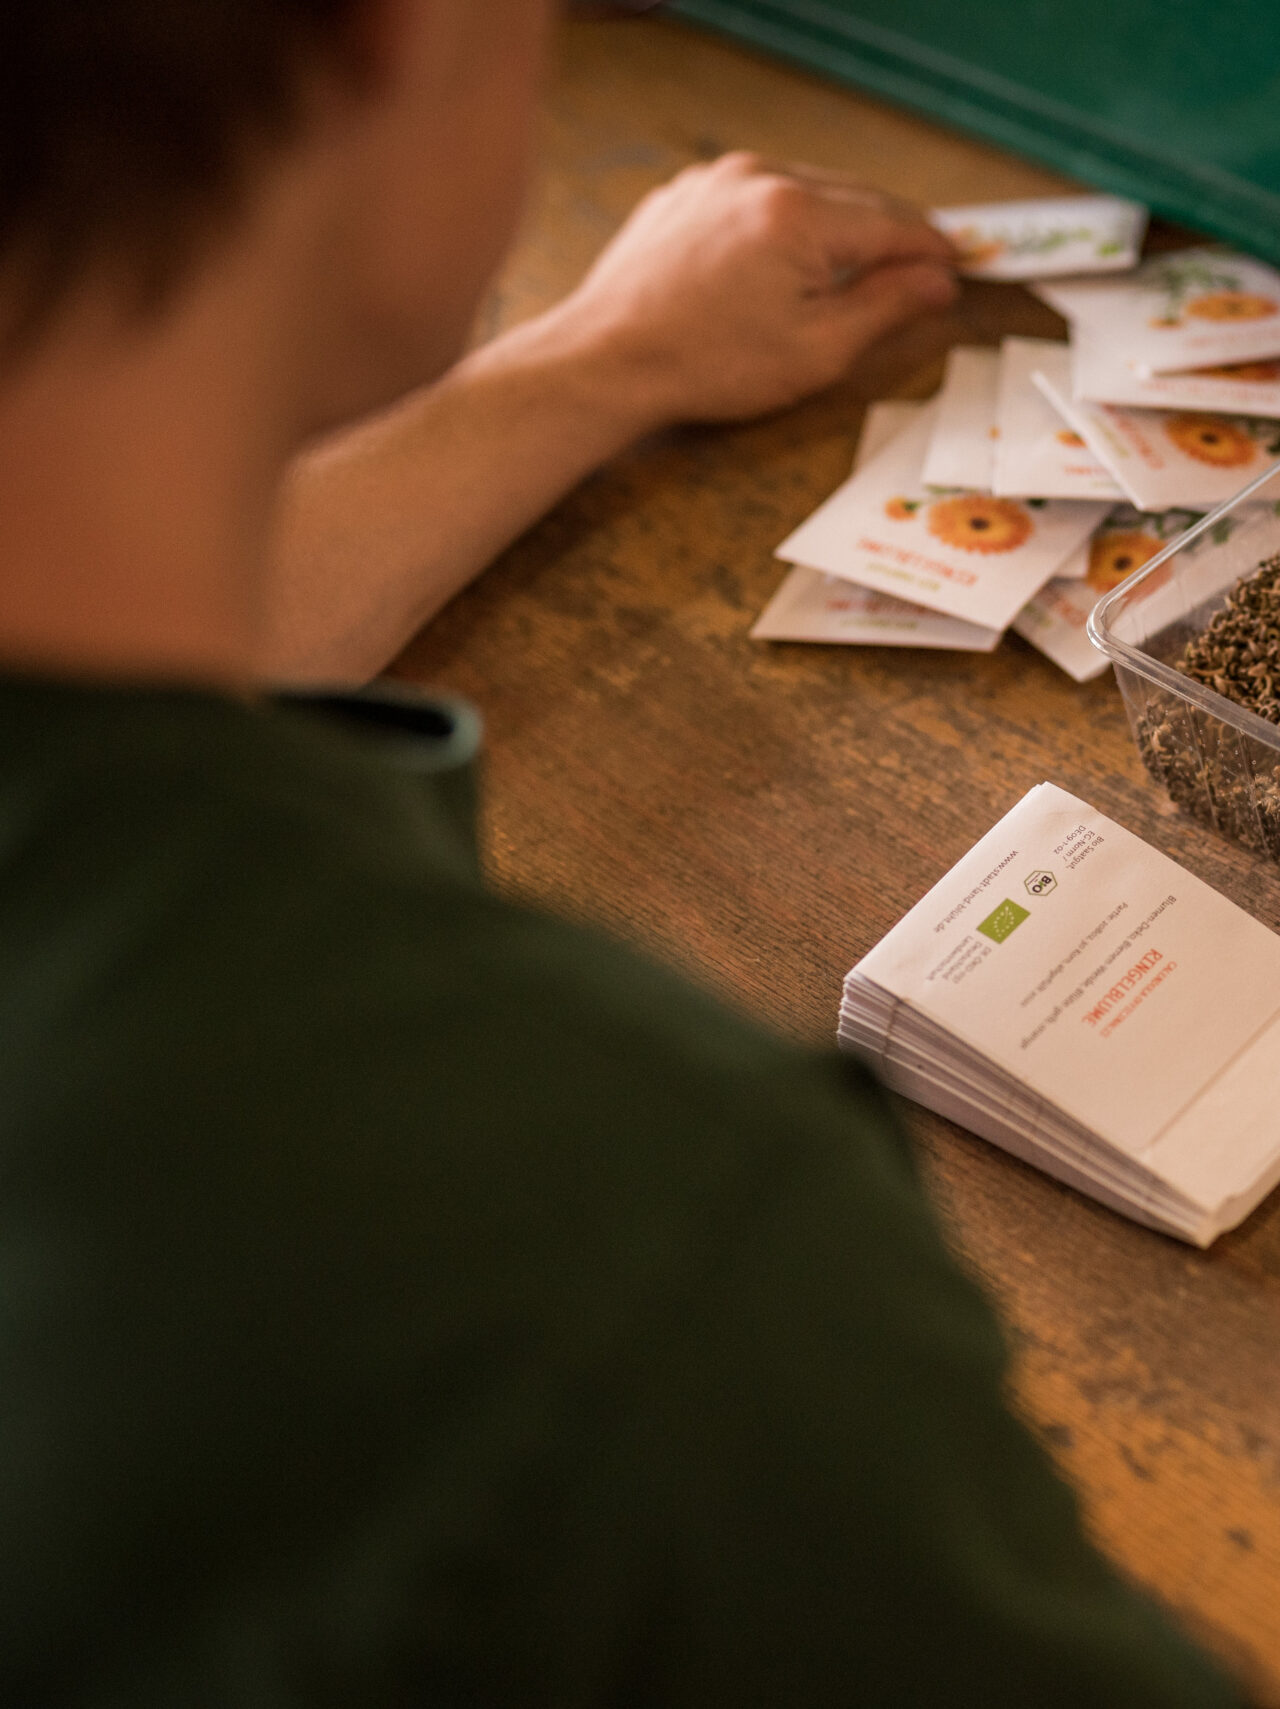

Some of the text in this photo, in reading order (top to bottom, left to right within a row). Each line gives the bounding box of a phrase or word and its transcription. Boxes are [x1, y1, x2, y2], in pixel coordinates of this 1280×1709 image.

[1064, 829, 1096, 857] EG-Norm
[1090, 834, 1105, 847] Bio
[1031, 874, 1053, 894] BIO
[1127, 894, 1177, 940] Blumen-Deko,
[1080, 947, 1163, 1026] RINGELBLUME
